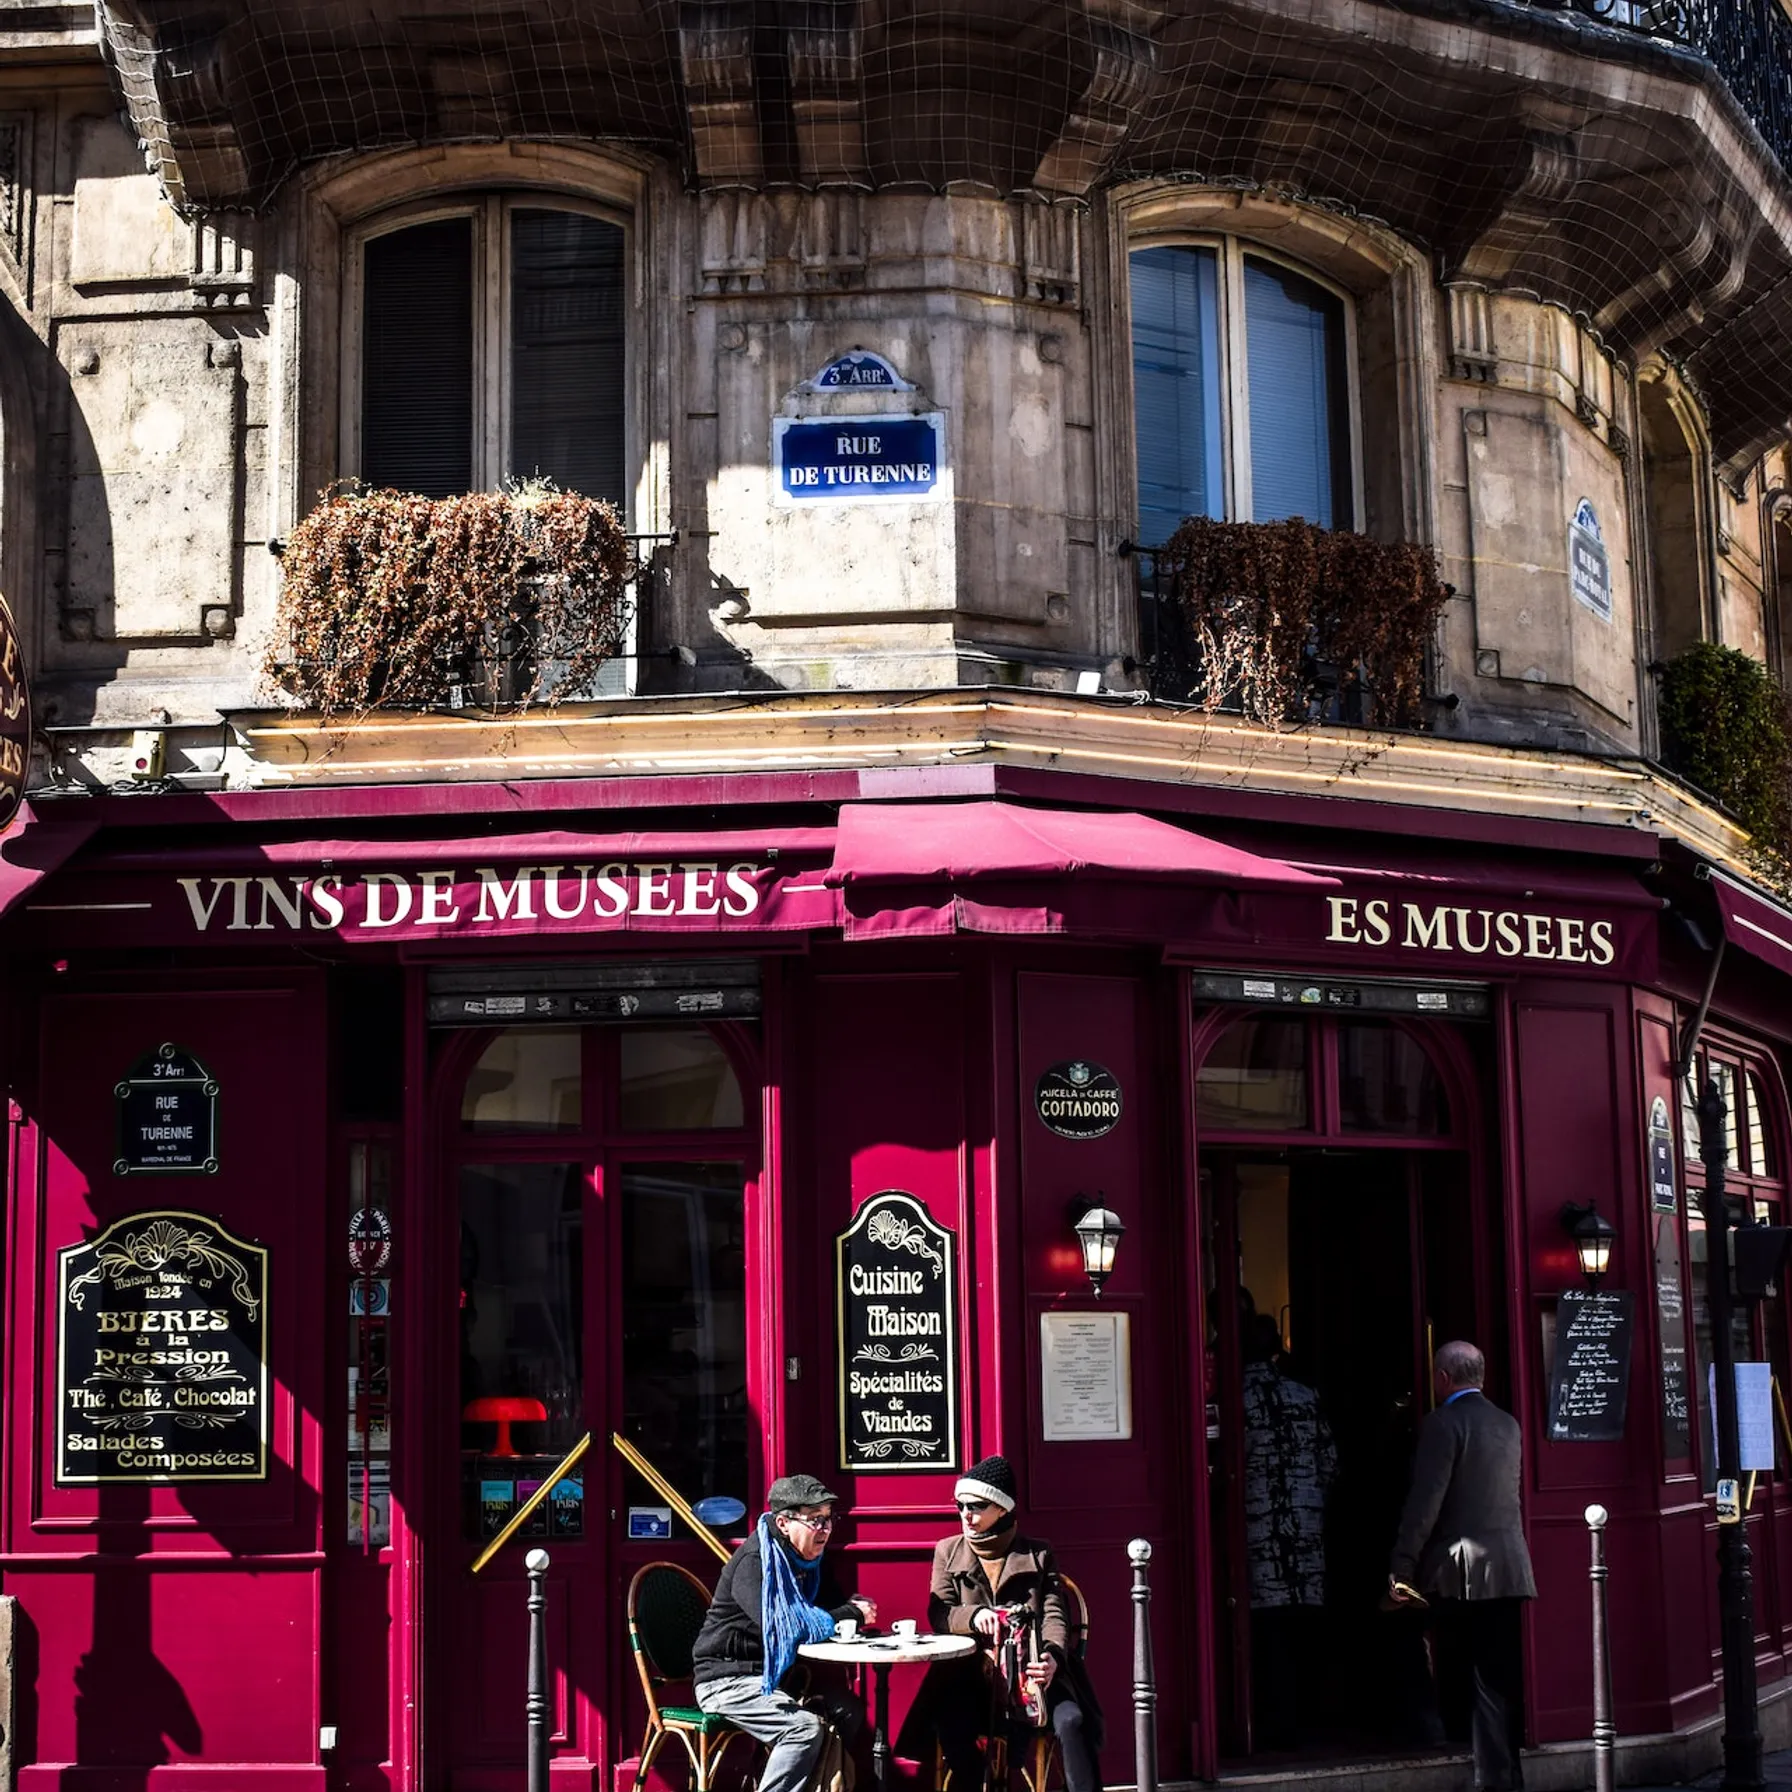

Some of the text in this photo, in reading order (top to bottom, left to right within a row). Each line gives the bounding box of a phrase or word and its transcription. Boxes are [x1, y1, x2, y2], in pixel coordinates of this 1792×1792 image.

[836, 436, 882, 455] RUE
[790, 463, 930, 486] DE TURENNE
[177, 862, 761, 931] VINS DE MUSEES
[1400, 902, 1615, 966] MUSEES
[155, 1096, 179, 1110] RUE
[1040, 1100, 1120, 1118] COSTADORO
[140, 1126, 194, 1141] TURENNE
[114, 1273, 152, 1290] Maison
[850, 1264, 924, 1296] Cuisine
[144, 1286, 183, 1300] 1924
[866, 1305, 942, 1337] Maison
[136, 1333, 190, 1346] à la
[94, 1348, 230, 1366] Pression
[850, 1371, 944, 1399] Spécialités
[174, 1386, 257, 1406] Chocolat
[888, 1396, 904, 1411] de
[861, 1409, 932, 1434] Viandes
[66, 1432, 165, 1452] Salades
[116, 1448, 256, 1472] Composées
